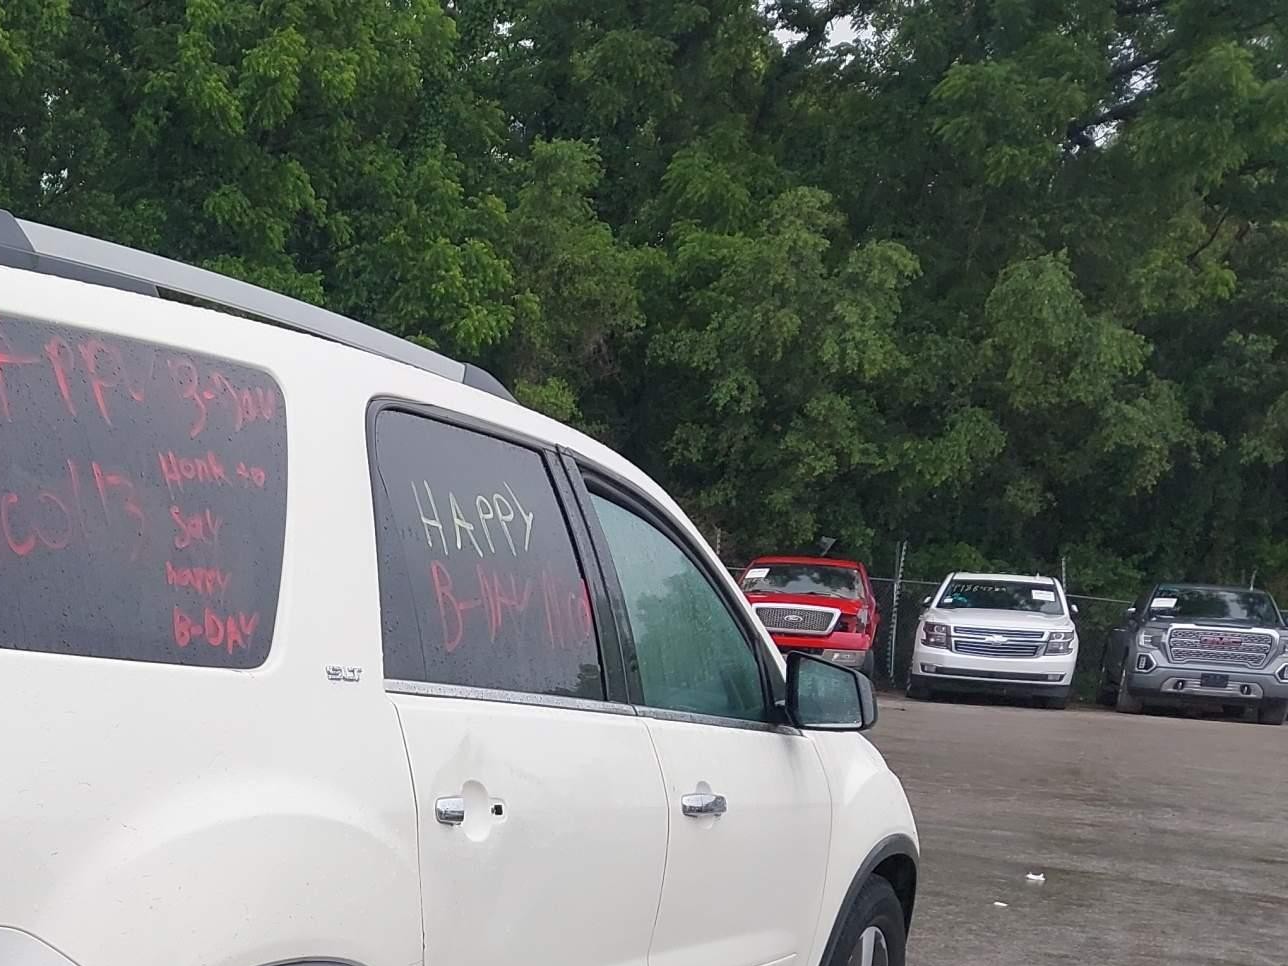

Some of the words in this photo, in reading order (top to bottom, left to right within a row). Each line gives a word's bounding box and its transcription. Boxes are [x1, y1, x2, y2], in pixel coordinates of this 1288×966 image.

[411, 479, 534, 558] HAPPY
[174, 607, 260, 655] B-DAY
[324, 664, 363, 683] SLT
